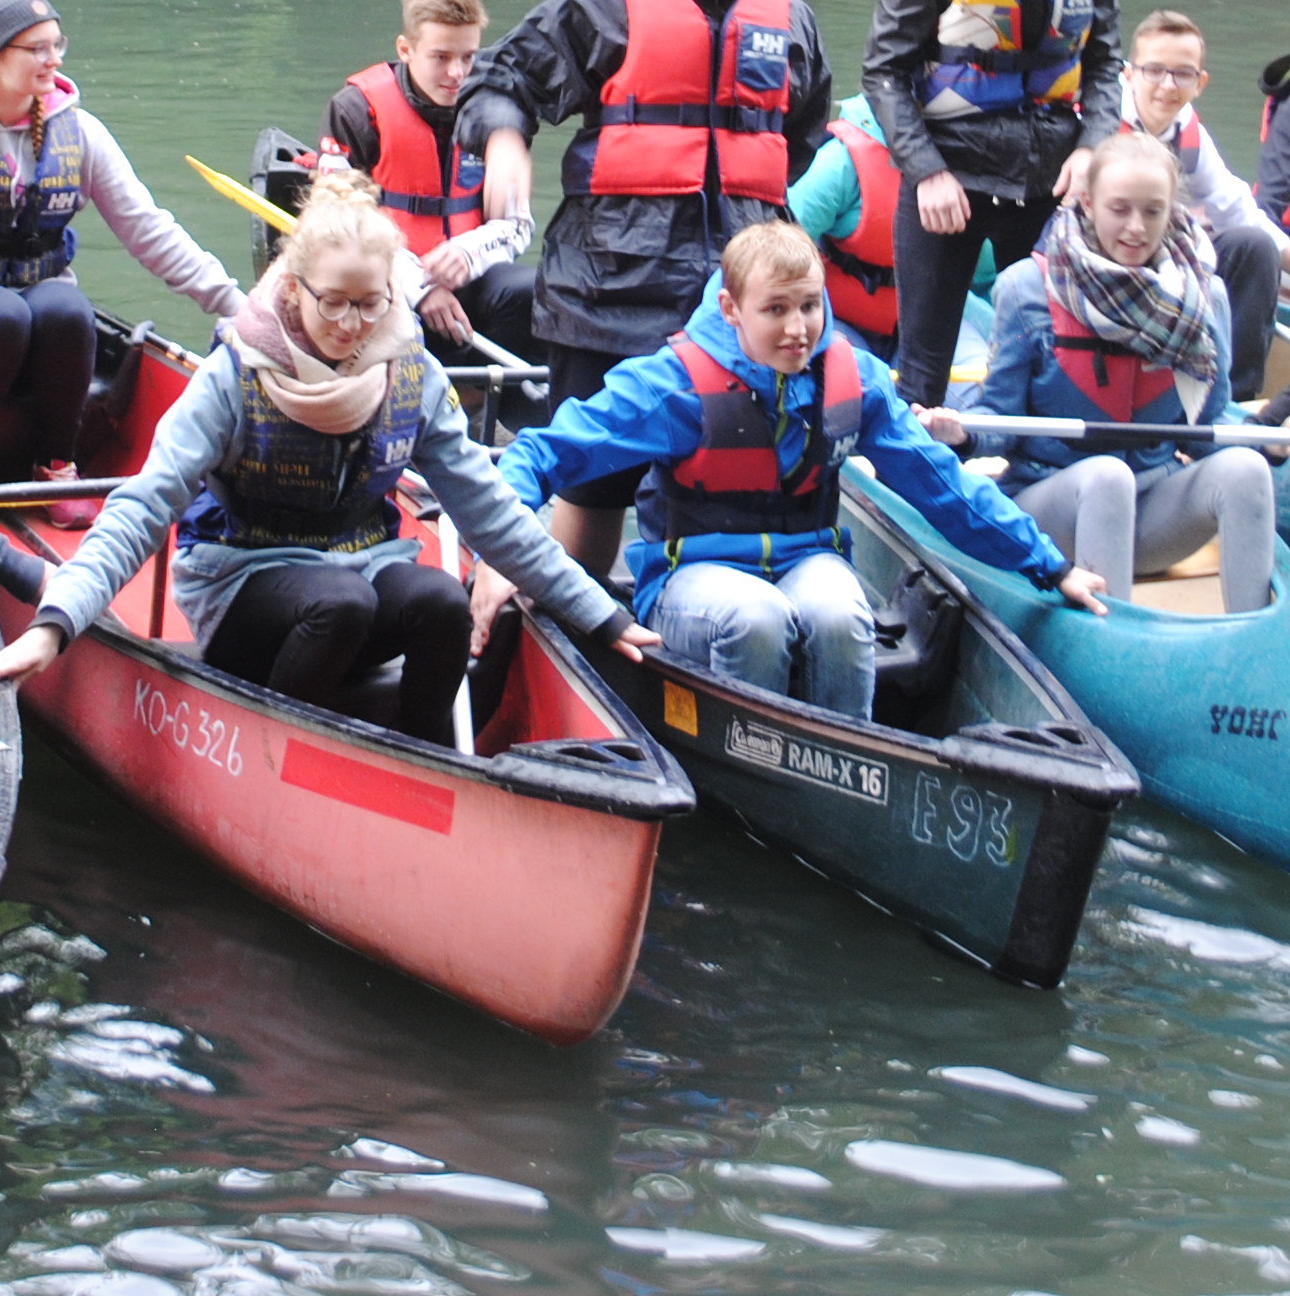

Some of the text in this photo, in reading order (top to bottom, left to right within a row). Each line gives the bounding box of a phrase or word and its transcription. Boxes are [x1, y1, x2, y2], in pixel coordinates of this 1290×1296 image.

[752, 32, 784, 55] HH
[48, 192, 76, 209] HH
[385, 437, 415, 464] HH
[788, 742, 853, 787] RAM-X
[858, 766, 882, 796] 16
